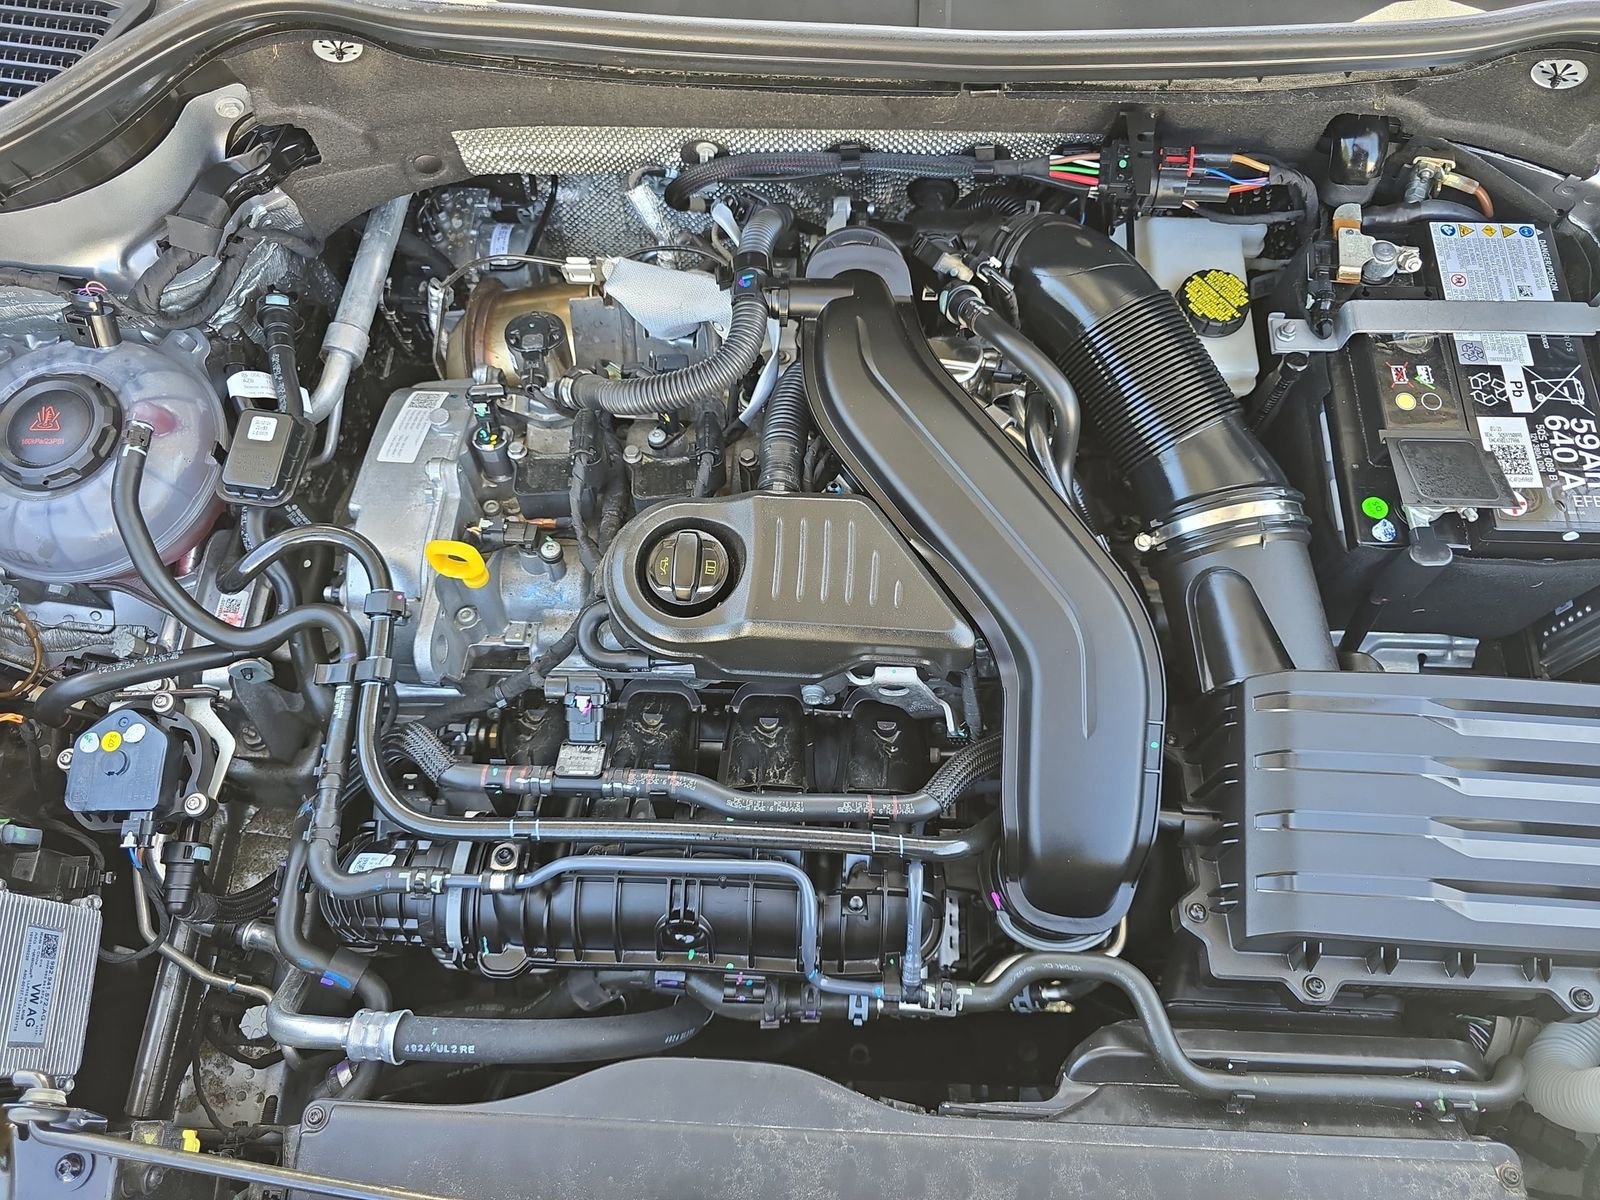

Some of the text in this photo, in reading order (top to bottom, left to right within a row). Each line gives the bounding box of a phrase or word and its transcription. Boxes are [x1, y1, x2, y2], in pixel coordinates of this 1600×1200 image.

[1538, 238, 1558, 290] DANGER/POISON
[1510, 380, 1524, 397] Pb
[1539, 442, 1551, 455] 915
[1544, 415, 1578, 462] 640
[1543, 457, 1556, 472] 089
[1559, 468, 1586, 491] A
[29, 983, 41, 1004] VW
[25, 1007, 36, 1028] AG
